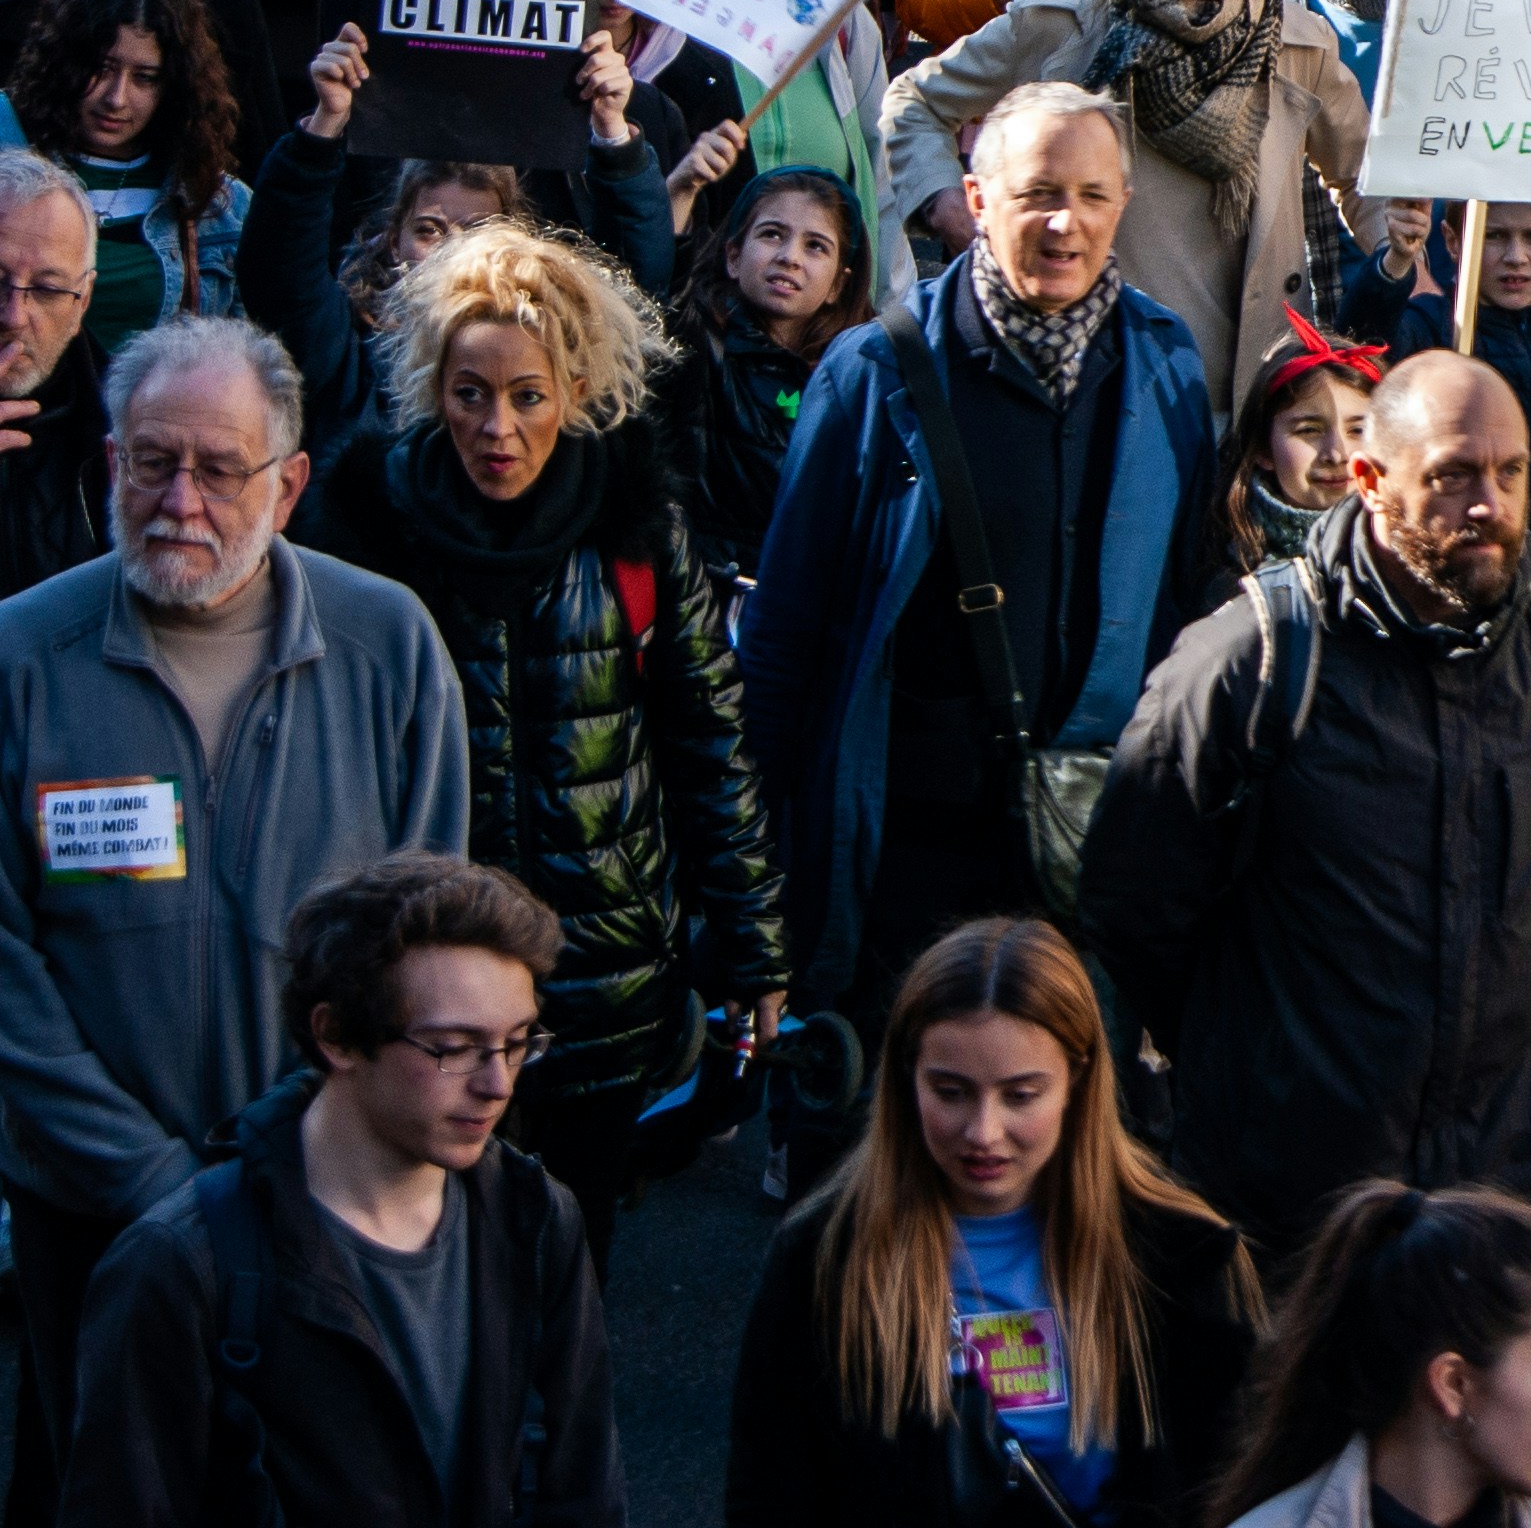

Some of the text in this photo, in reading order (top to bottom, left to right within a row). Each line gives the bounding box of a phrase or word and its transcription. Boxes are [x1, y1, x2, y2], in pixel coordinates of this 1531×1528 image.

[1418, 116, 1473, 157] EN
[53, 794, 150, 816] FIN DU MONDE
[55, 816, 139, 837] FIN DU MOIS
[56, 839, 100, 858] MÊME
